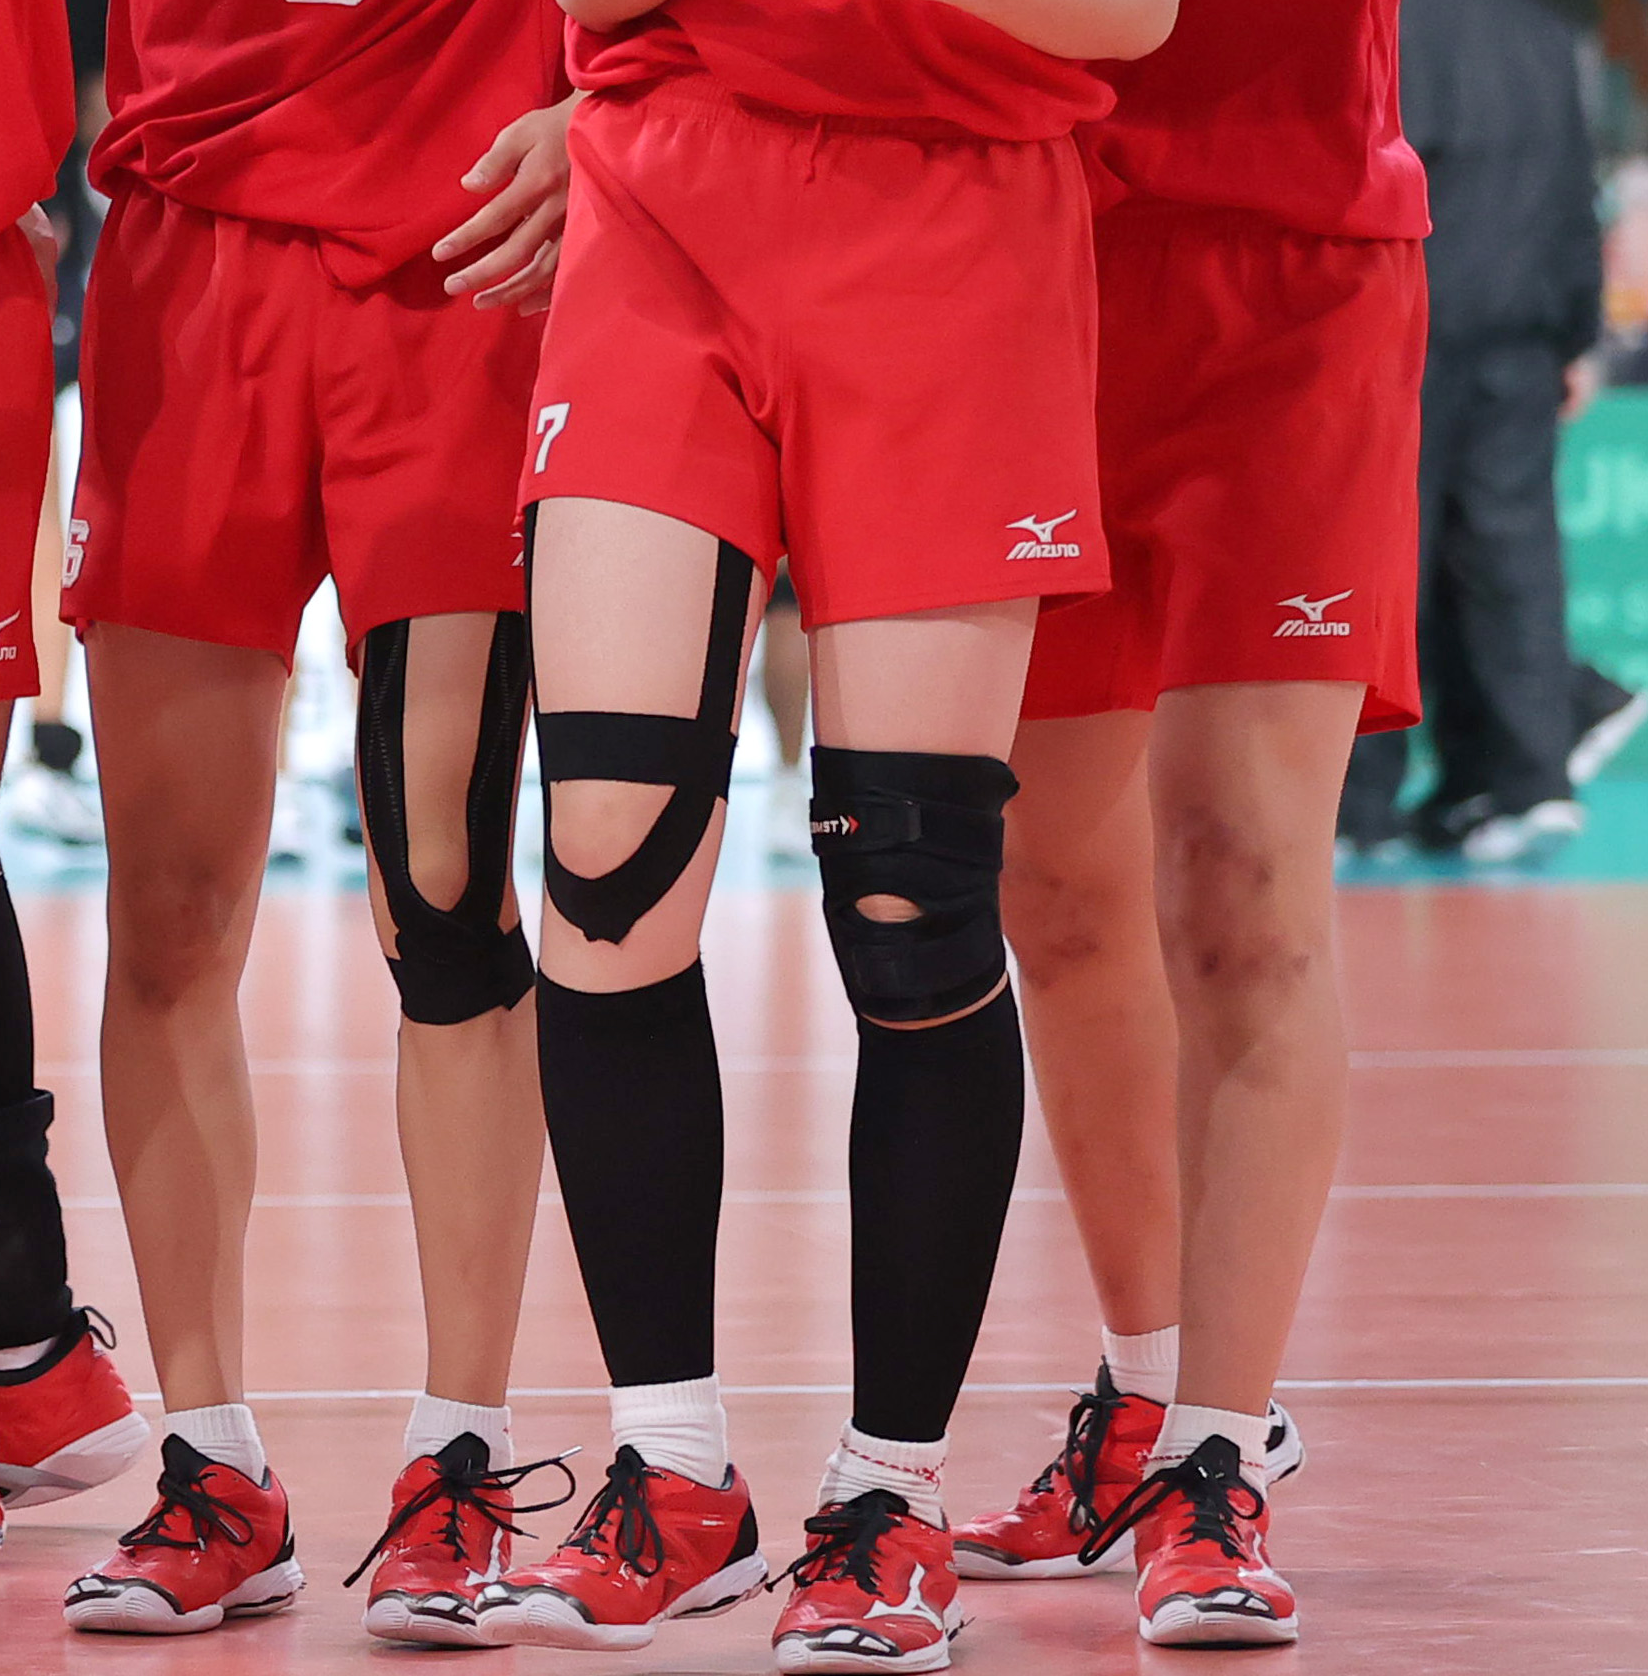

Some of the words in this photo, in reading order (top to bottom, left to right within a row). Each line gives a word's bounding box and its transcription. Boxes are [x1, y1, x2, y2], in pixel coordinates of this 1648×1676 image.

[535, 402, 570, 473] 7
[62, 518, 91, 589] 6
[1006, 538, 1080, 561] MIZUNO
[1273, 618, 1351, 639] MIZUNO
